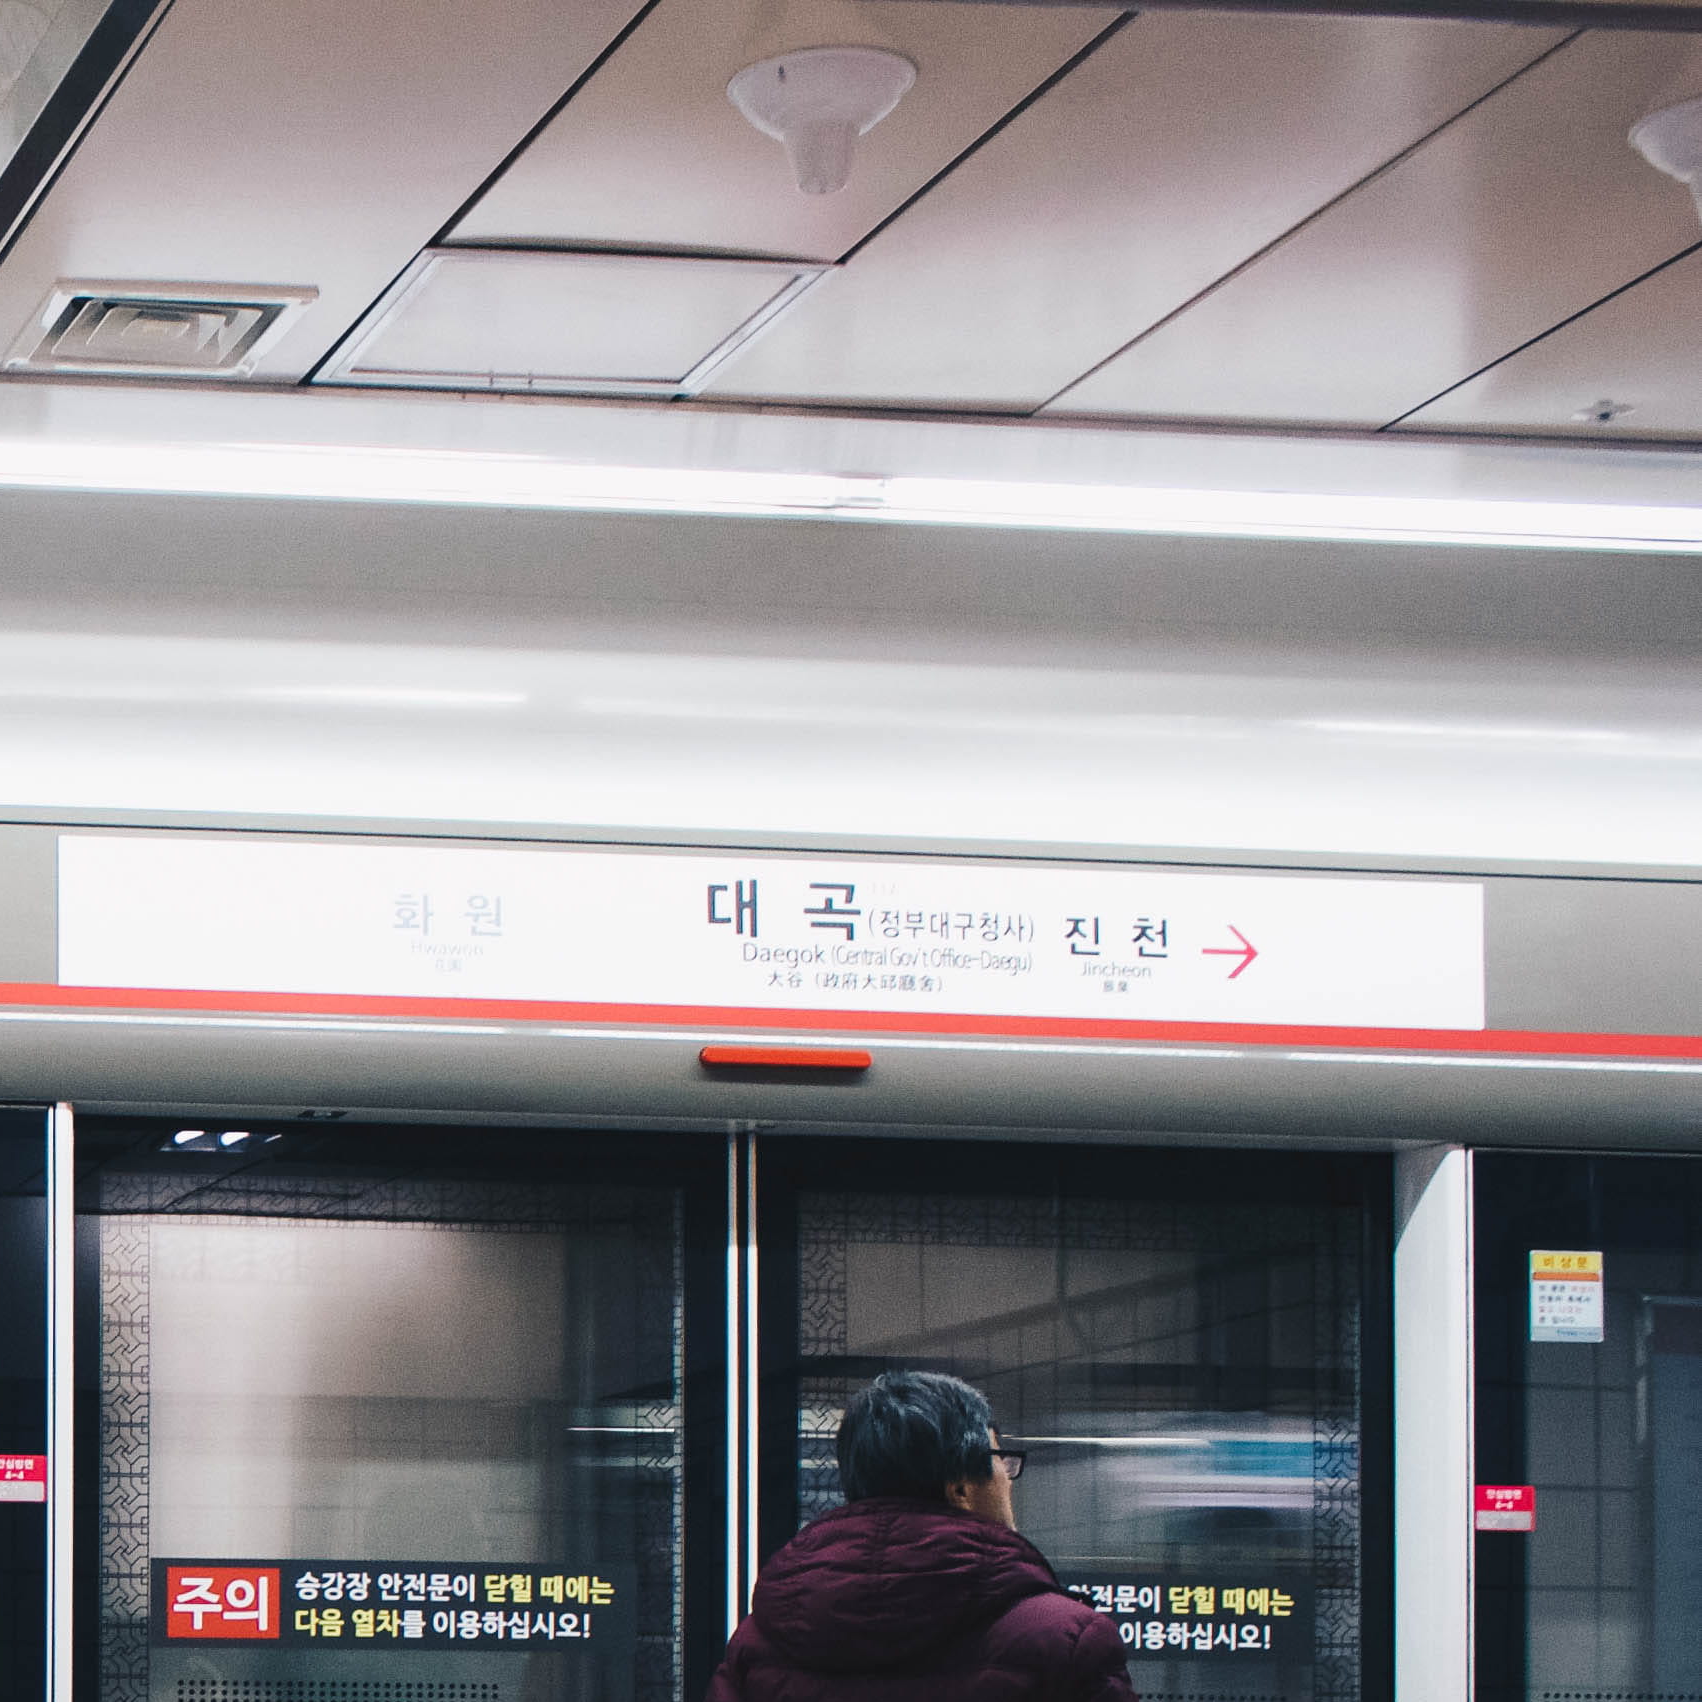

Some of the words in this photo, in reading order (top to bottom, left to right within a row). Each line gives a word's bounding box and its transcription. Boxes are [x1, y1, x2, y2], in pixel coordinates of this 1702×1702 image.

[868, 908, 1035, 943] (정부대구청사)
[742, 942, 826, 969] Daegok
[1081, 961, 1152, 979] Jincheon
[295, 1571, 371, 1601] 승강장
[377, 1573, 476, 1602] 안전문이
[484, 1574, 532, 1603] 닫힐
[539, 1575, 615, 1604] 때에는
[1168, 1586, 1216, 1615] 닫힐
[1222, 1587, 1295, 1617] 때에는
[172, 1575, 270, 1632] 주의
[295, 1608, 345, 1638] 다음
[351, 1608, 426, 1639] 열차를
[432, 1610, 591, 1640] 이용하십시오!
[1118, 1621, 1271, 1651] 이용하십시오!
